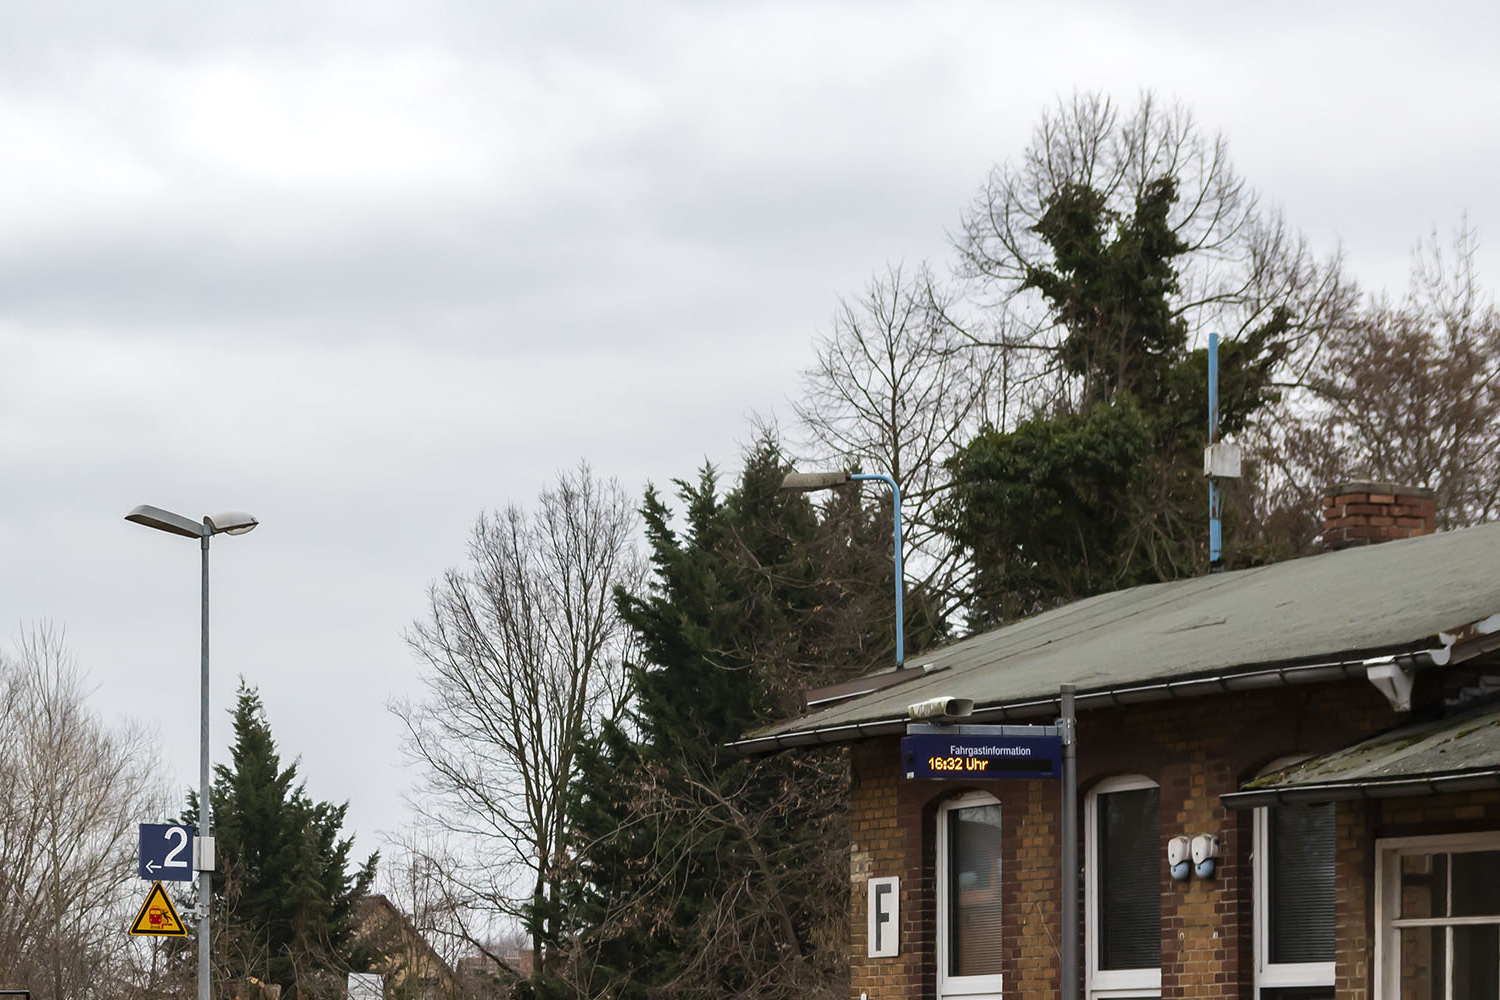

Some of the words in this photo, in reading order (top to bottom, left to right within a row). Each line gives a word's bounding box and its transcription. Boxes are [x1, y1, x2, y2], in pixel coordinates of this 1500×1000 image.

[928, 757, 963, 771] 16:32
[966, 757, 988, 771] Uhr
[950, 745, 1031, 757] Fahrgastinformation
[163, 826, 188, 868] 2
[875, 883, 892, 952] F
